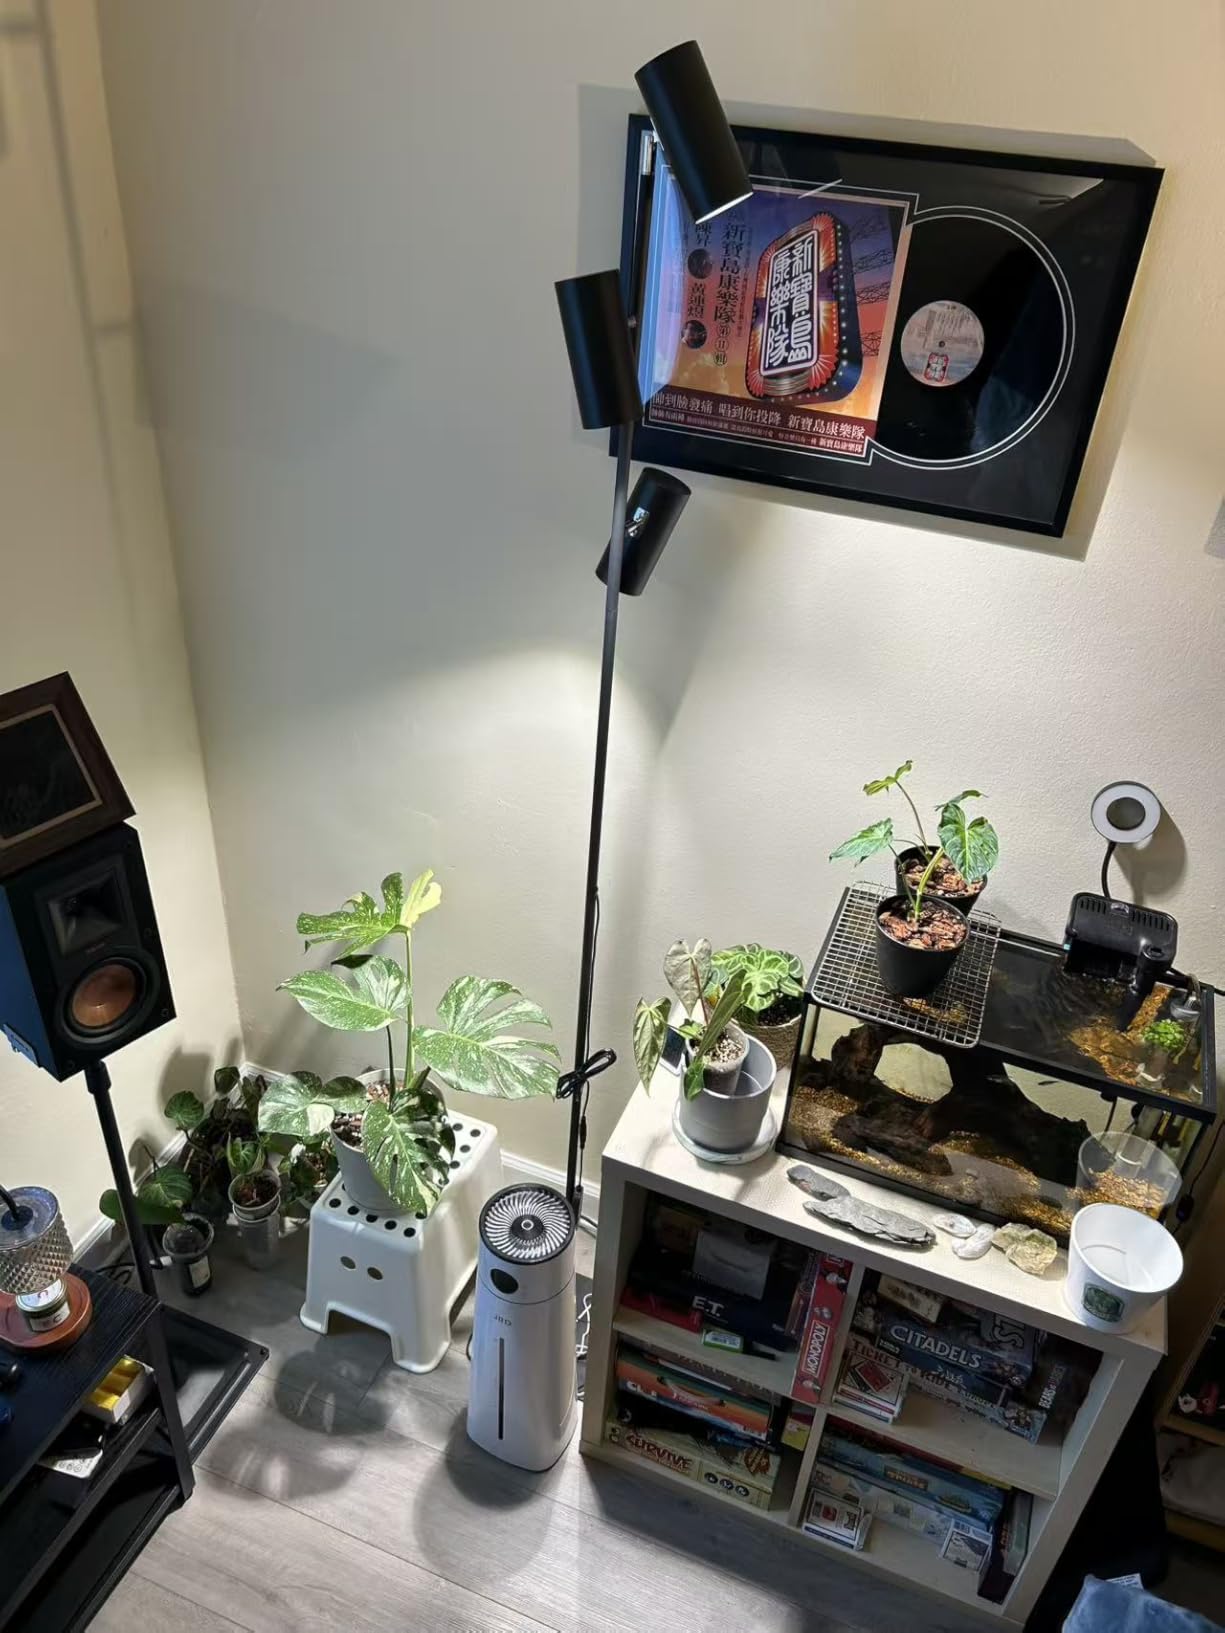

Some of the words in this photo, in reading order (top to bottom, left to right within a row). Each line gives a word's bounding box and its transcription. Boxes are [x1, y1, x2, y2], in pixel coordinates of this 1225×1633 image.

[788, 414, 866, 440] 新寶島康樂隊
[692, 1295, 725, 1317] E.T.
[806, 1323, 828, 1375] MONOPOLY
[852, 1339, 901, 1370] TICKET
[889, 1325, 983, 1369] CITADELS
[1038, 1386, 1056, 1410] BEARS
[626, 1432, 692, 1470] SURVIVE
